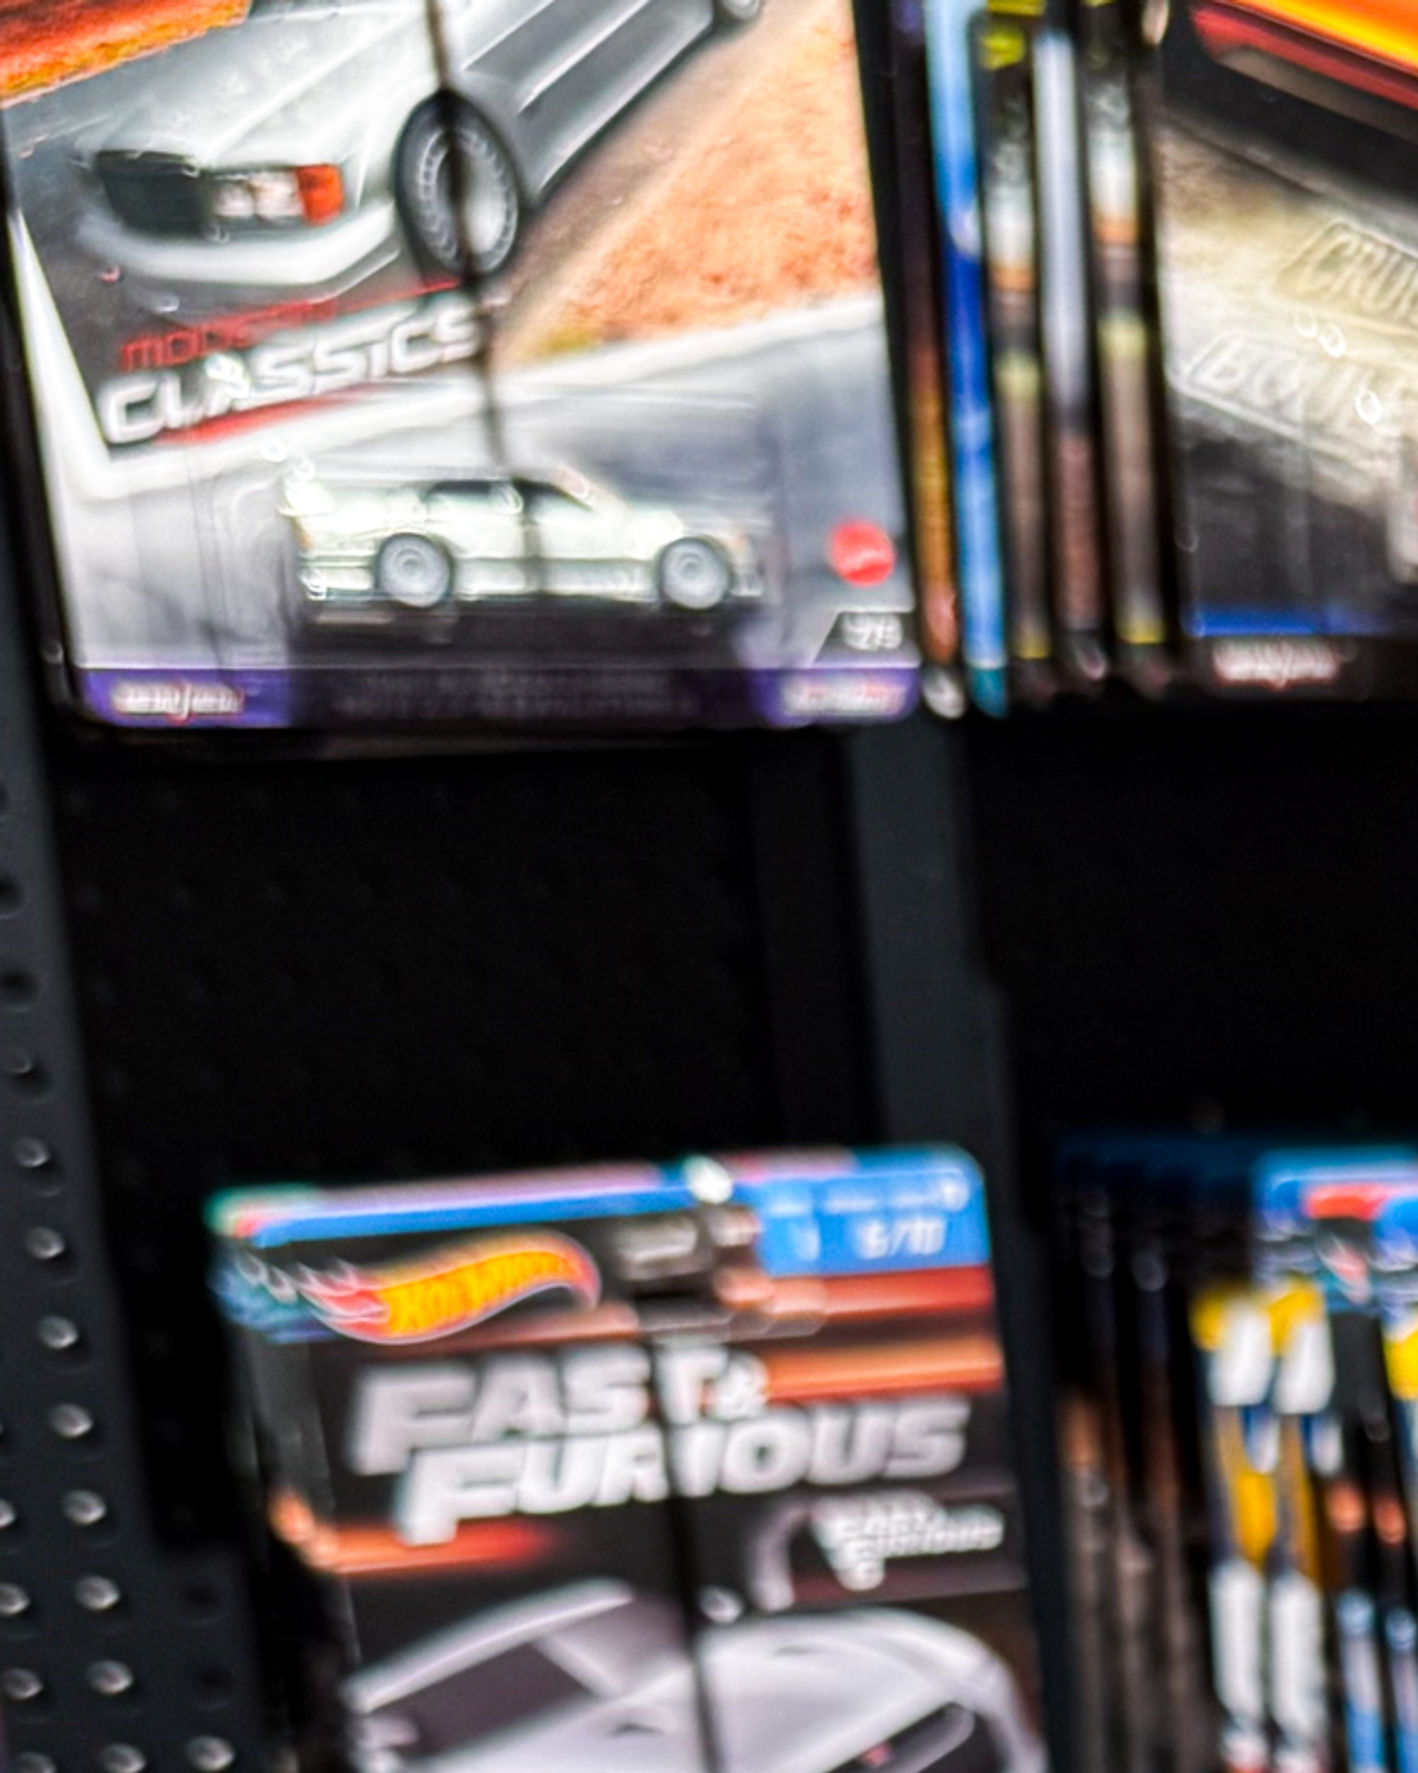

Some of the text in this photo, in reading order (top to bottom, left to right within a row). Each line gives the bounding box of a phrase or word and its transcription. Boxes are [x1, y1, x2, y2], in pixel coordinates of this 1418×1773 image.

[101, 296, 482, 446] CLASSICS
[350, 1334, 733, 1476] FAST
[394, 1394, 972, 1547] FURIOUS
